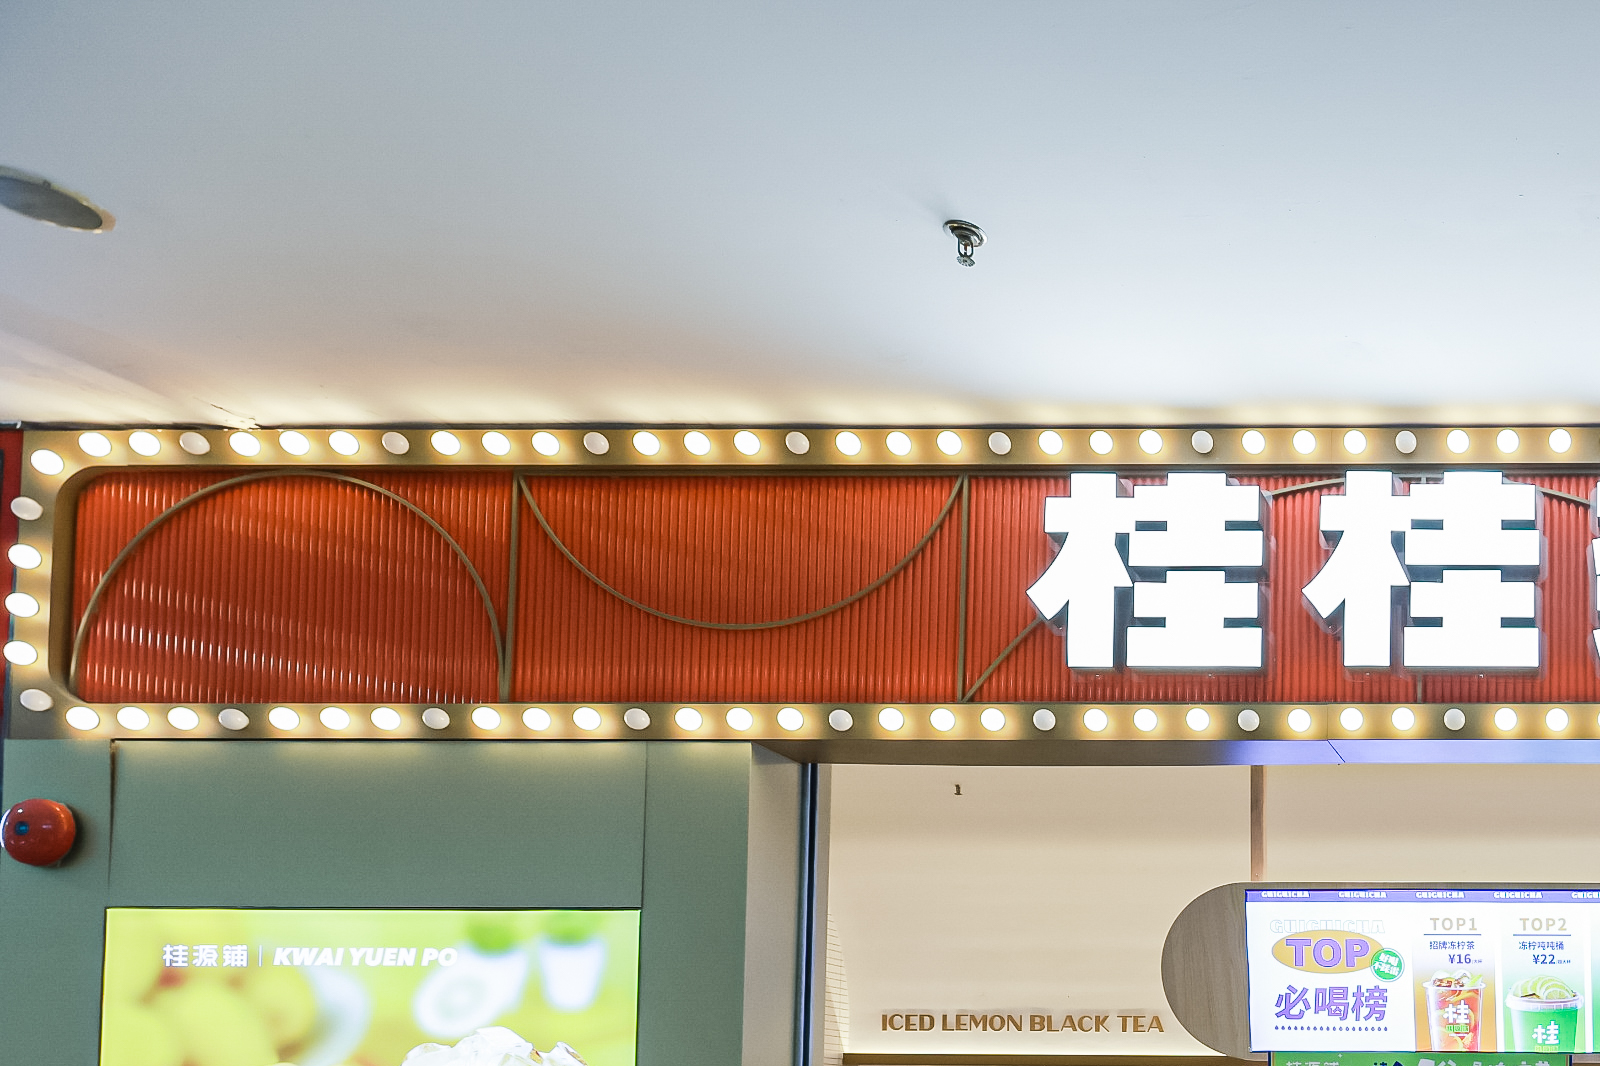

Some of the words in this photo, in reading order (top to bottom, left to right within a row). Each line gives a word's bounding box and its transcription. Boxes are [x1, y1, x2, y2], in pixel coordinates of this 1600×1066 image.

[1429, 917, 1477, 931] TOP1
[1520, 918, 1567, 931] TOP2
[1285, 938, 1370, 968] TOP
[1429, 940, 1475, 950] 招牌冻柠茶
[273, 947, 346, 966] KWAI
[350, 947, 417, 966] YUEN
[421, 947, 458, 967] PO
[1274, 984, 1388, 1021] 必喝榜
[1442, 999, 1470, 1024] 桂
[881, 1014, 935, 1032] ICED
[941, 1014, 1023, 1032] LEMON
[1029, 1014, 1110, 1033] BLACK
[1116, 1015, 1165, 1033] TEA
[1532, 1020, 1560, 1045] 桂
